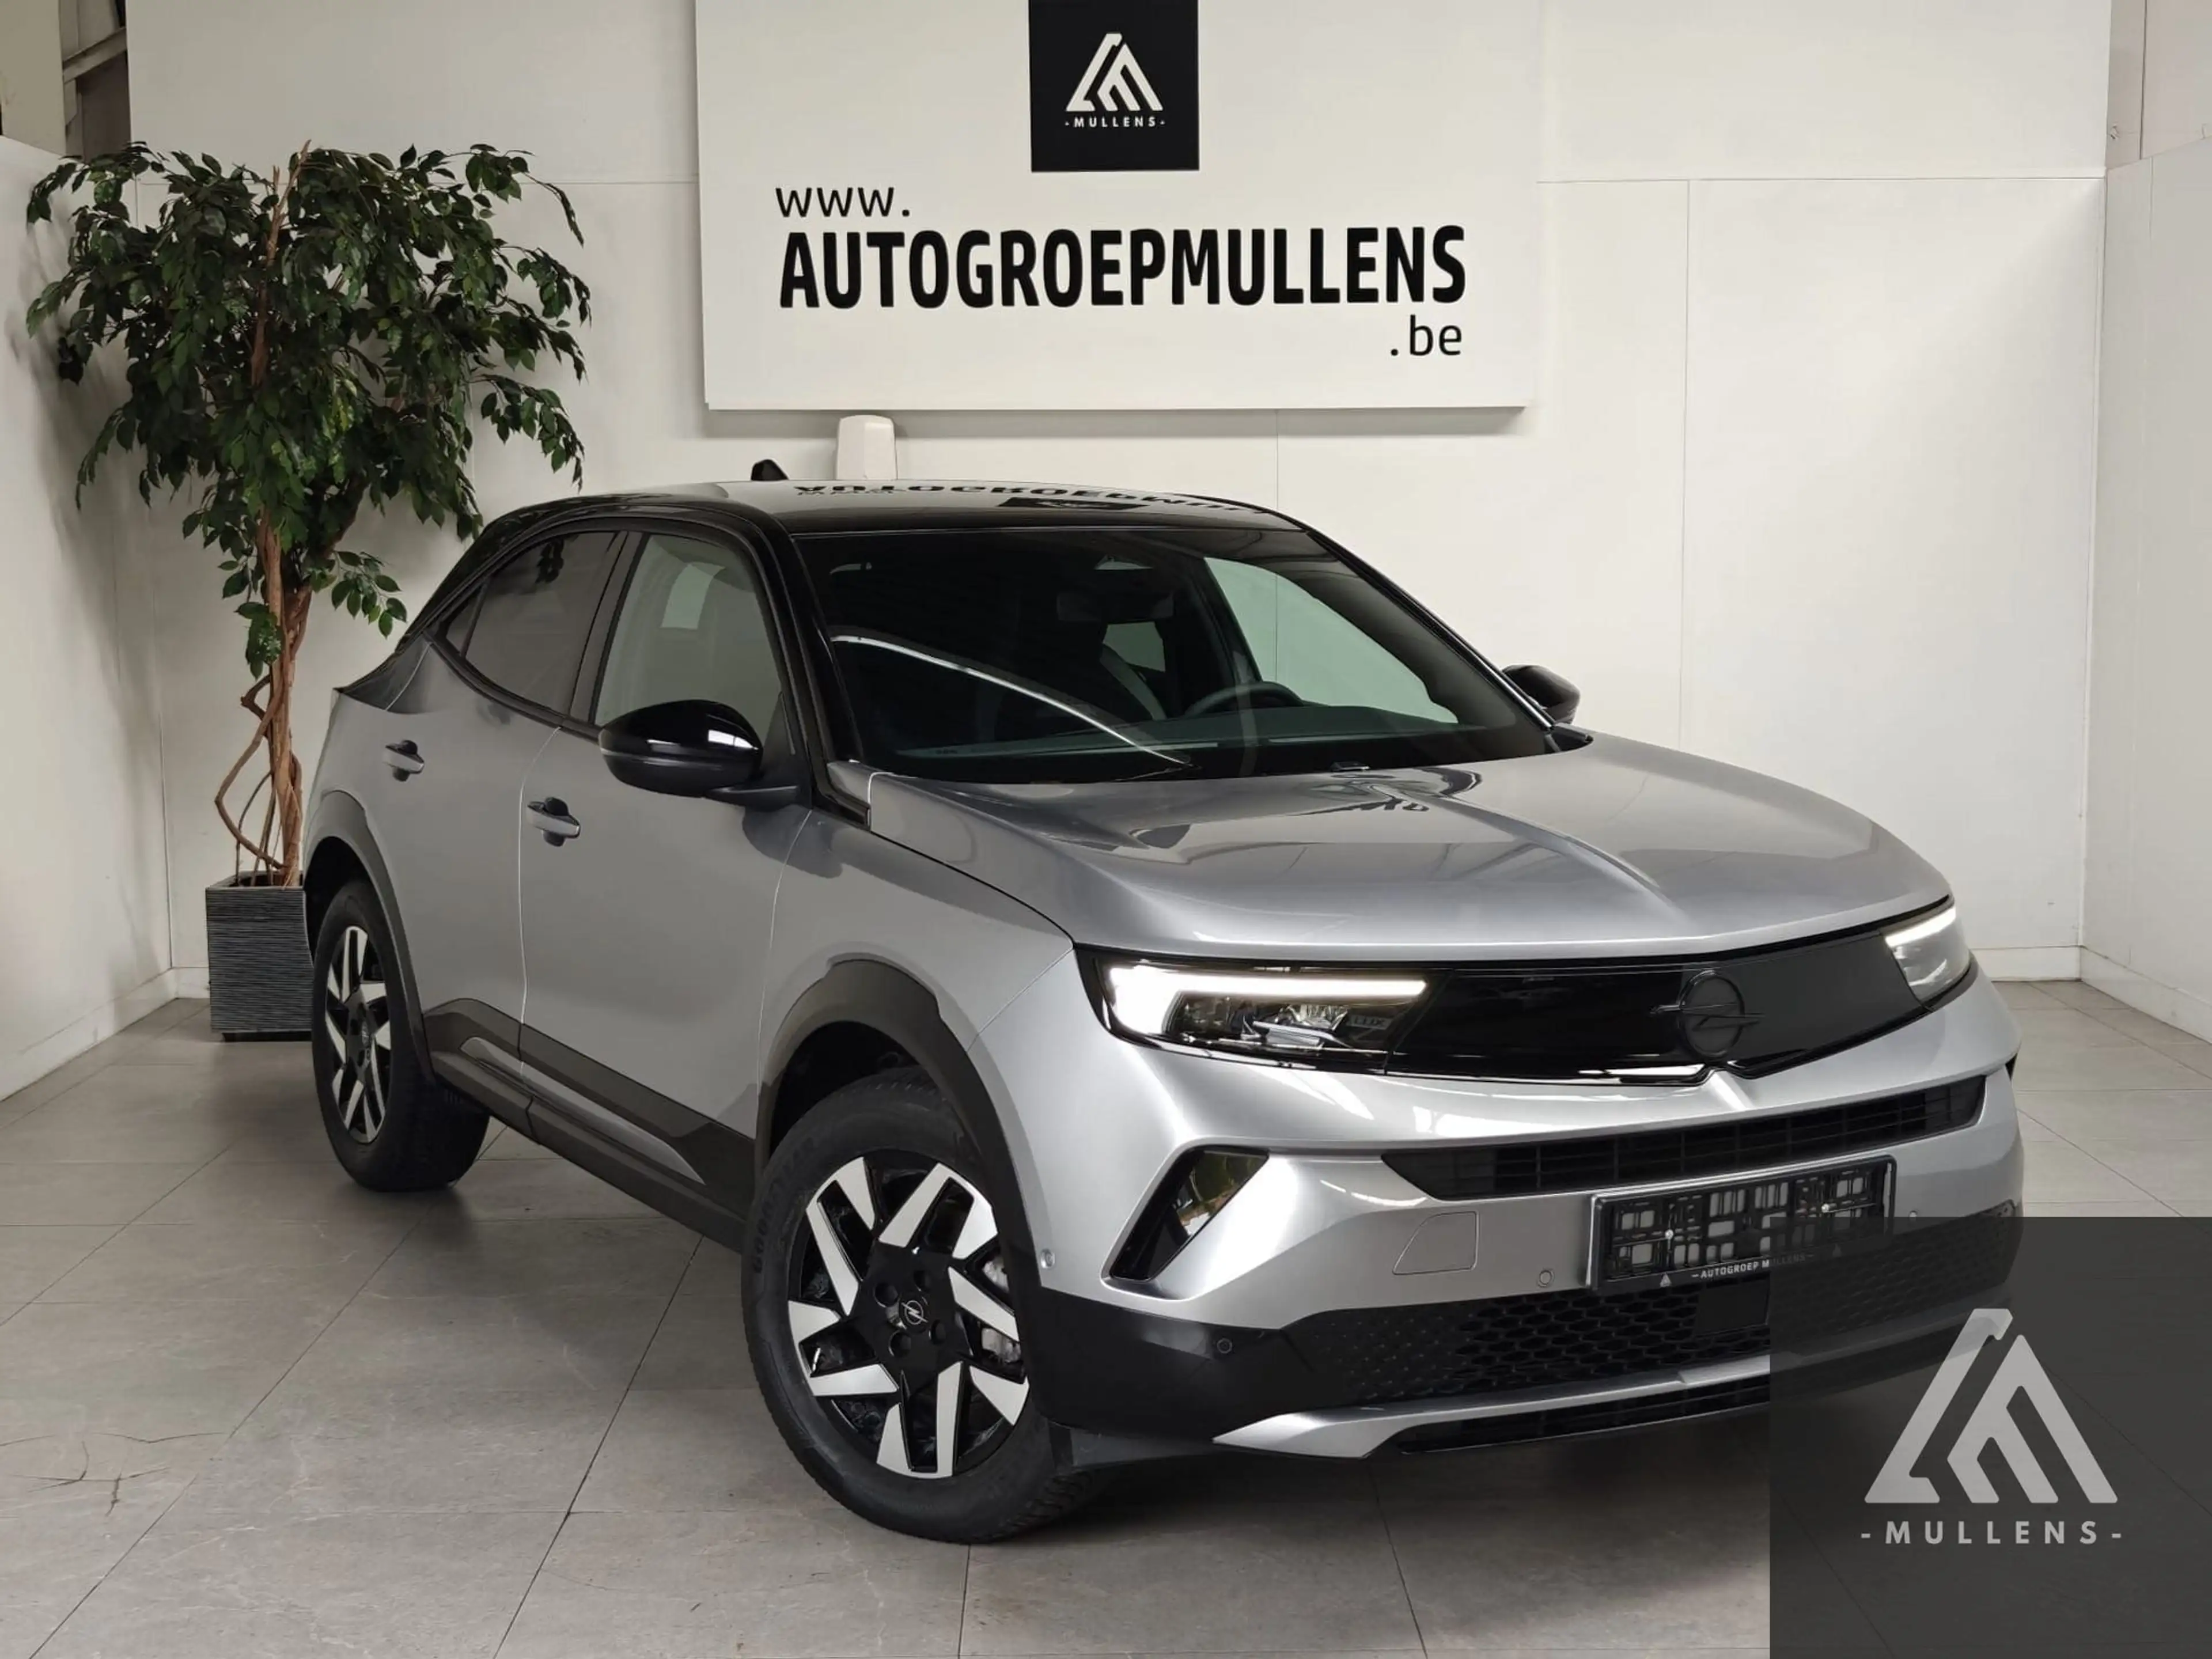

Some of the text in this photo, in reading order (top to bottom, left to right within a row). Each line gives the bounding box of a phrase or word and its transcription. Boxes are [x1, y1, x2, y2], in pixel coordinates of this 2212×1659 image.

[775, 187, 910, 218] www.
[780, 225, 1465, 309] AUTOGROEPMULLENS
[1391, 314, 1461, 356] .be
